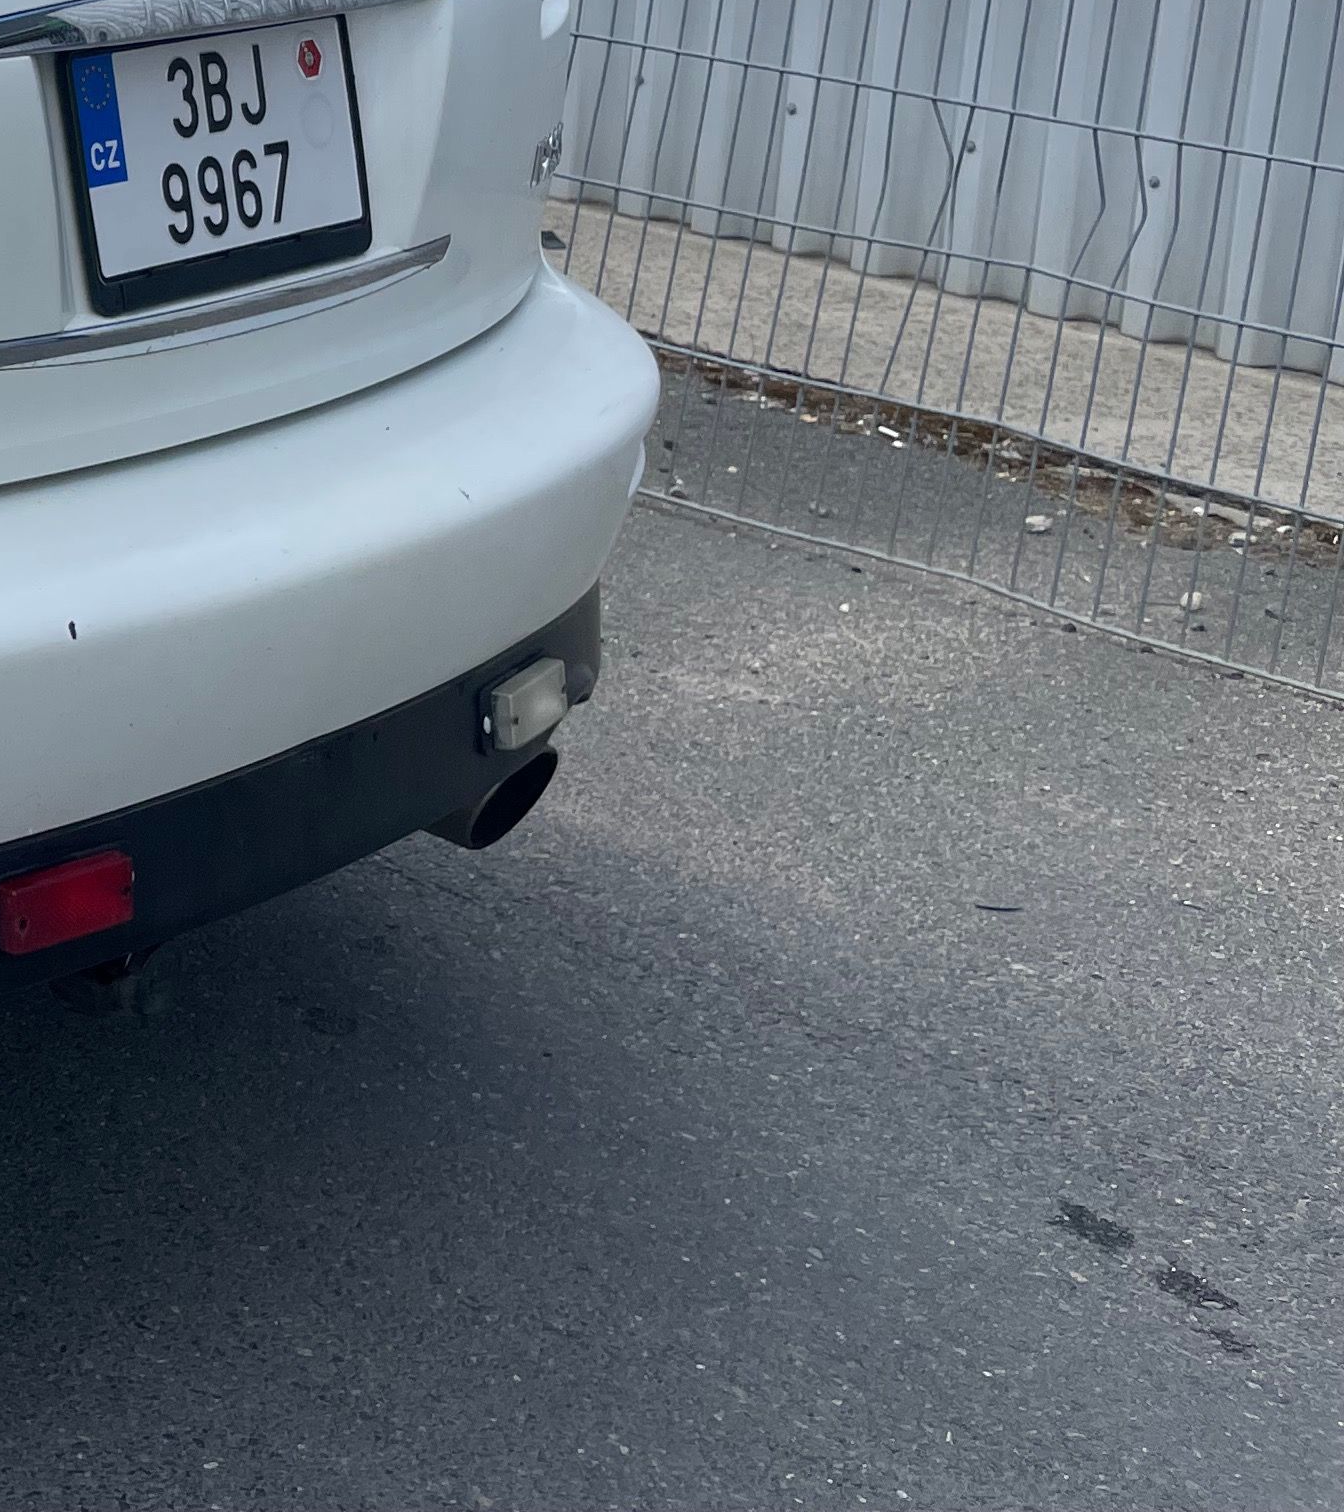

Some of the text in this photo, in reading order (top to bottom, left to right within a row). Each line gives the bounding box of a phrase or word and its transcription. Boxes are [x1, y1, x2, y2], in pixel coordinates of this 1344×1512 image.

[167, 44, 267, 138] 3BJ
[90, 139, 121, 172] CZ
[162, 140, 289, 245] 9967
